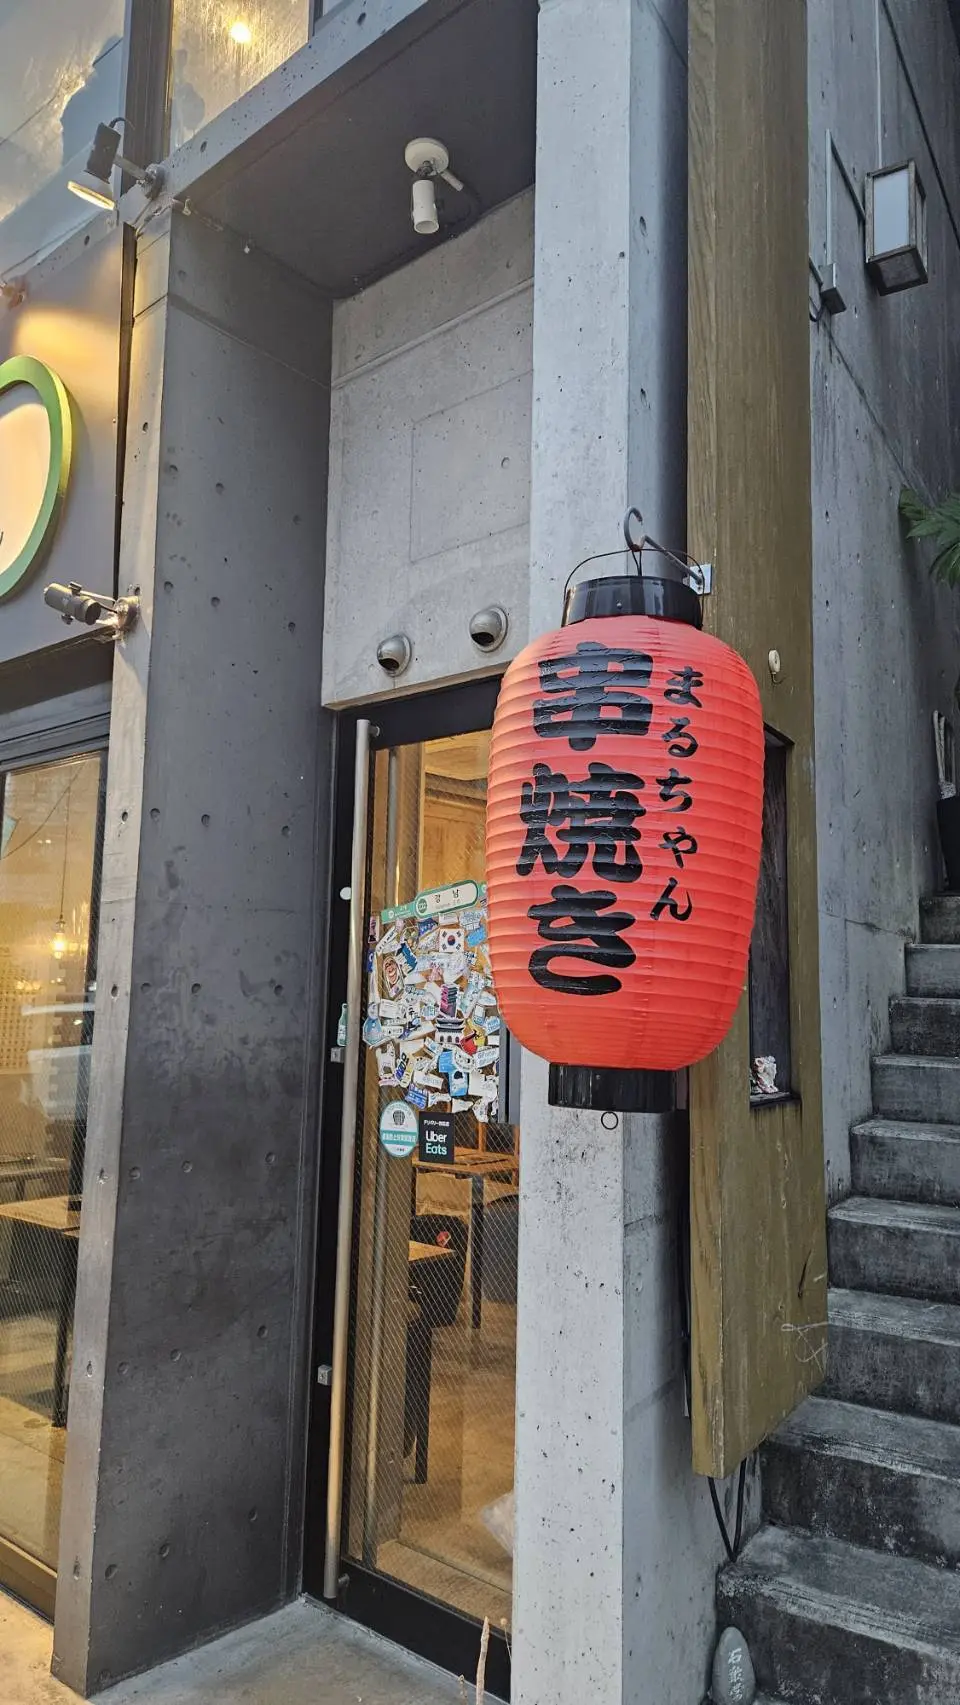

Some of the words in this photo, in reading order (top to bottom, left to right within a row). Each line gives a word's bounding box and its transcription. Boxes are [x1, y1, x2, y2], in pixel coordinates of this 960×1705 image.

[515, 641, 654, 996] 串焼き
[649, 665, 704, 922] まるちゃん
[425, 1130, 447, 1142] Uber
[425, 1142, 447, 1155] Eats
